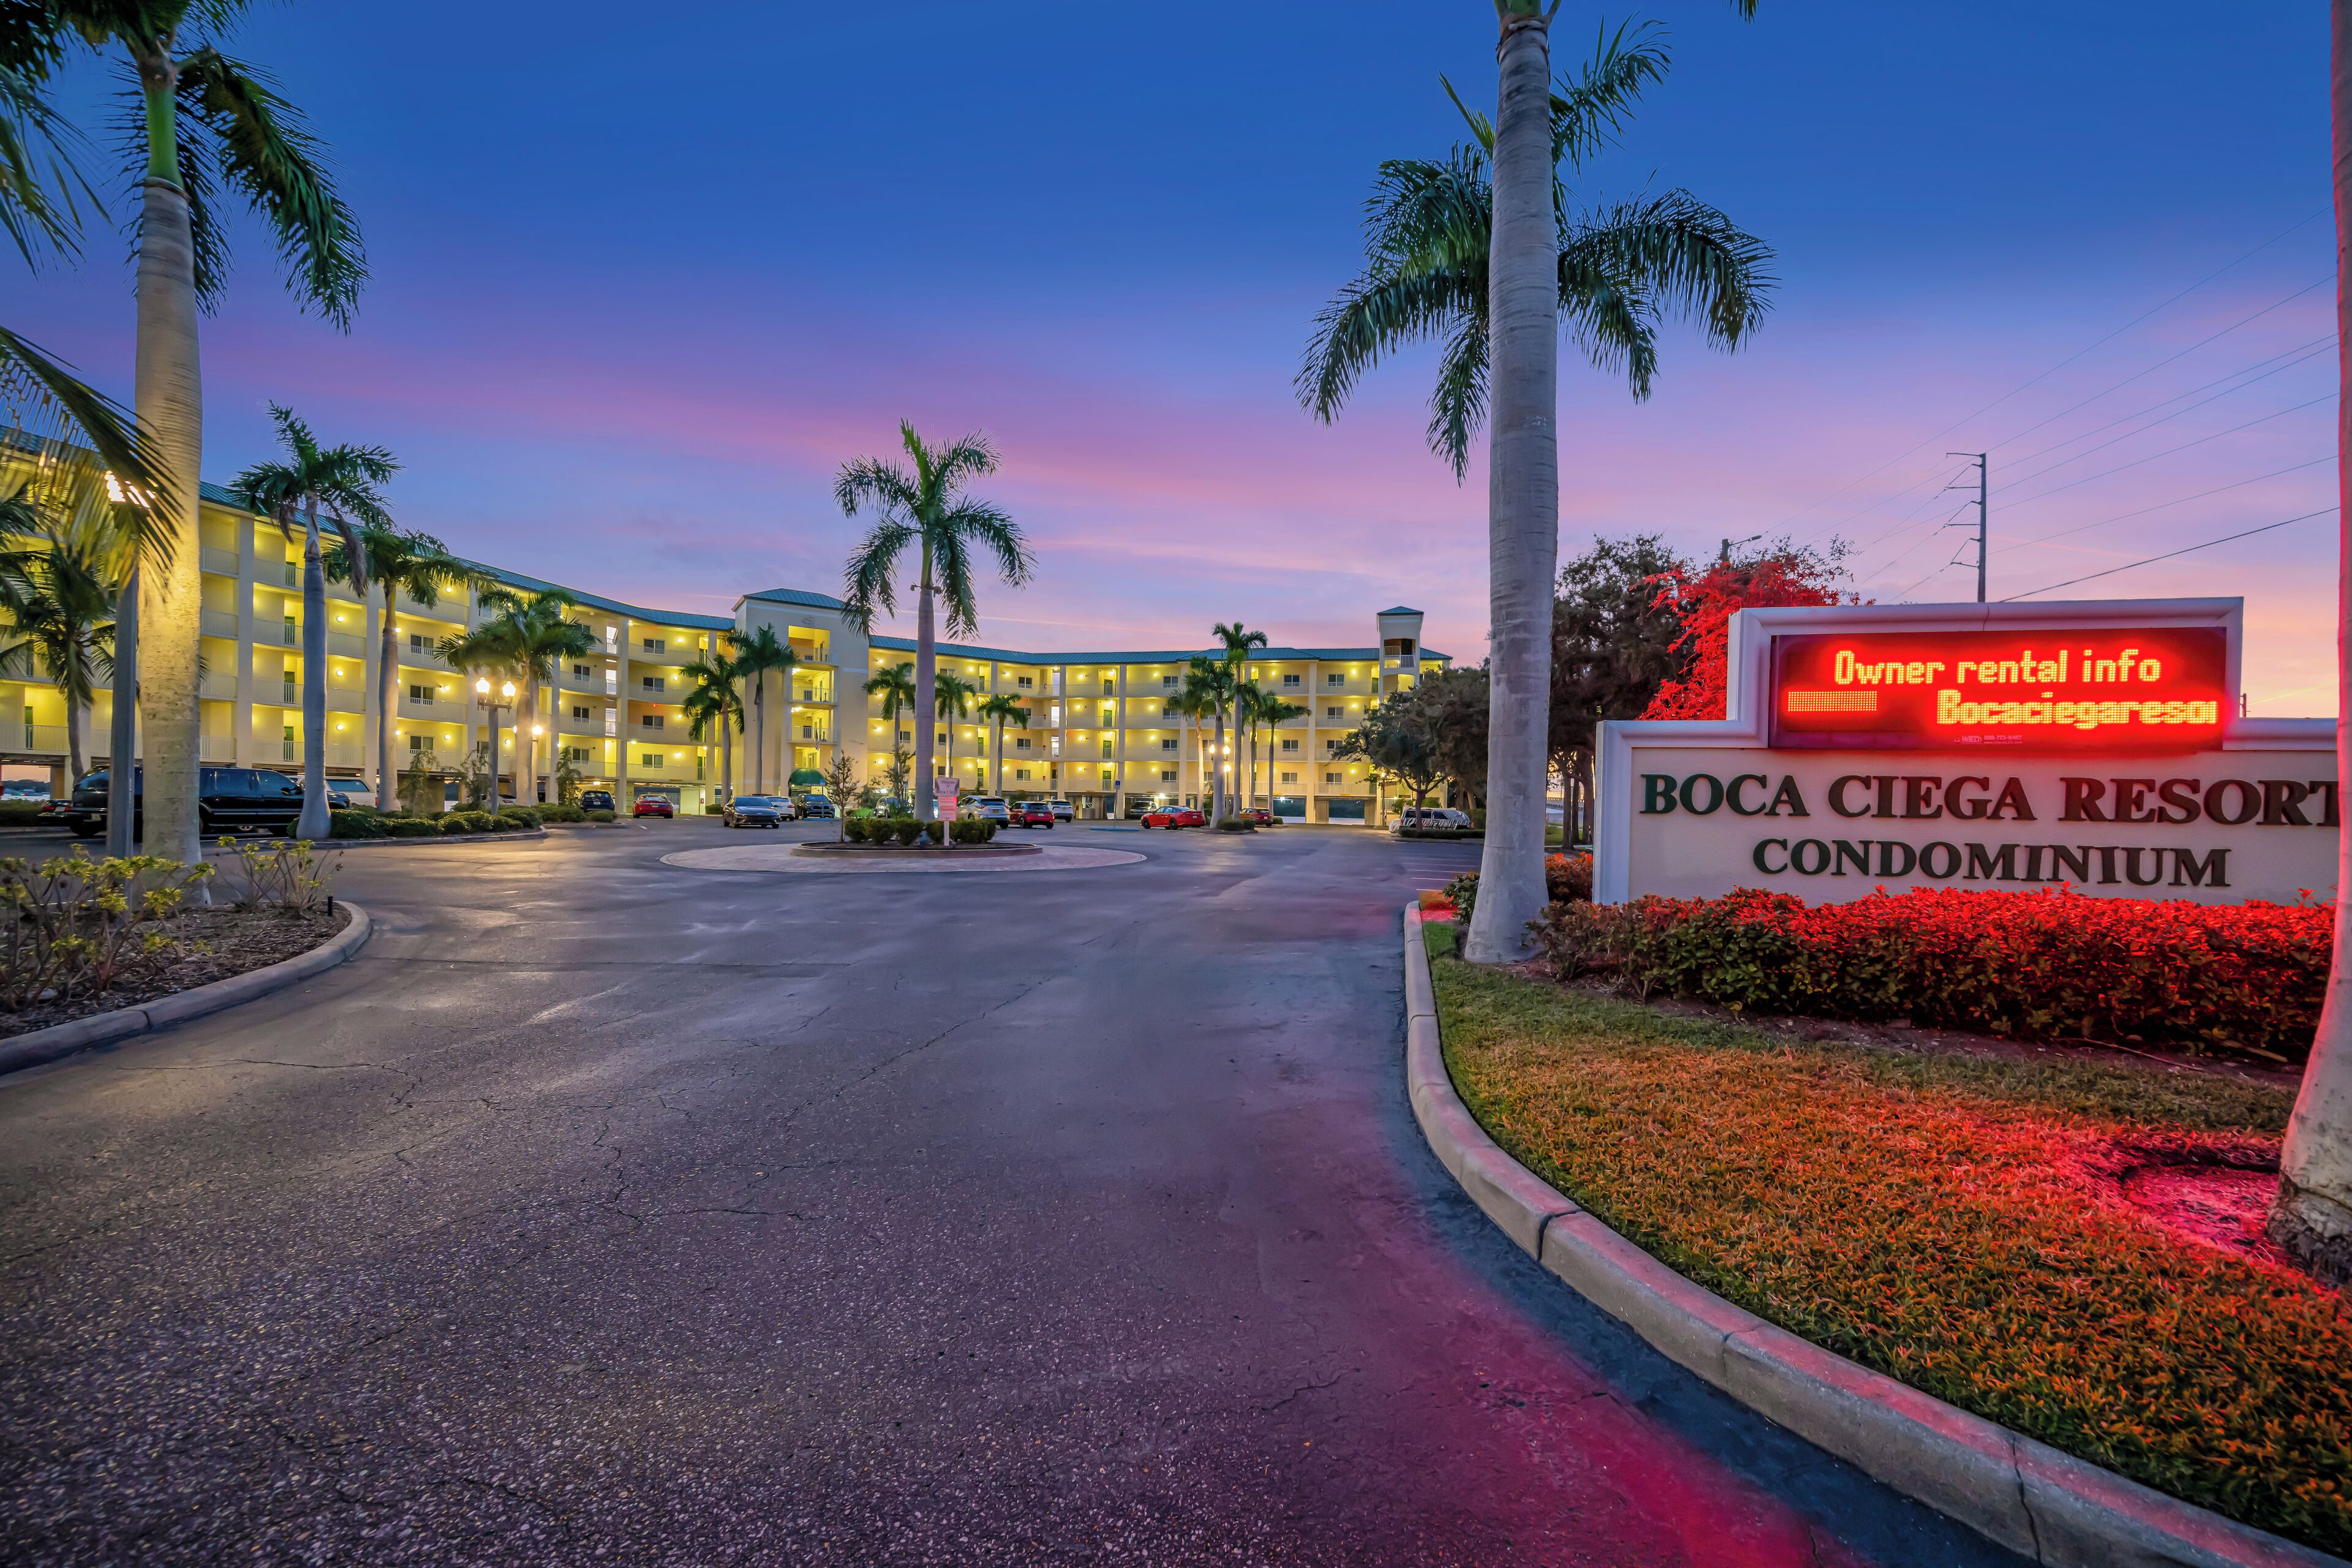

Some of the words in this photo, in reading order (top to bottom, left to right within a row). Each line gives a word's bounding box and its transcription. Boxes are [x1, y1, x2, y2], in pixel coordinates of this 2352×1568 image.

[1835, 650, 1945, 684] Owner
[1958, 650, 2068, 684] rental
[2082, 649, 2162, 682] info
[1639, 773, 1811, 816] BOCA
[1828, 775, 2038, 821] CIEGA
[2058, 777, 2340, 827] RESORT
[1752, 838, 2232, 887] CONDOMINIUM
